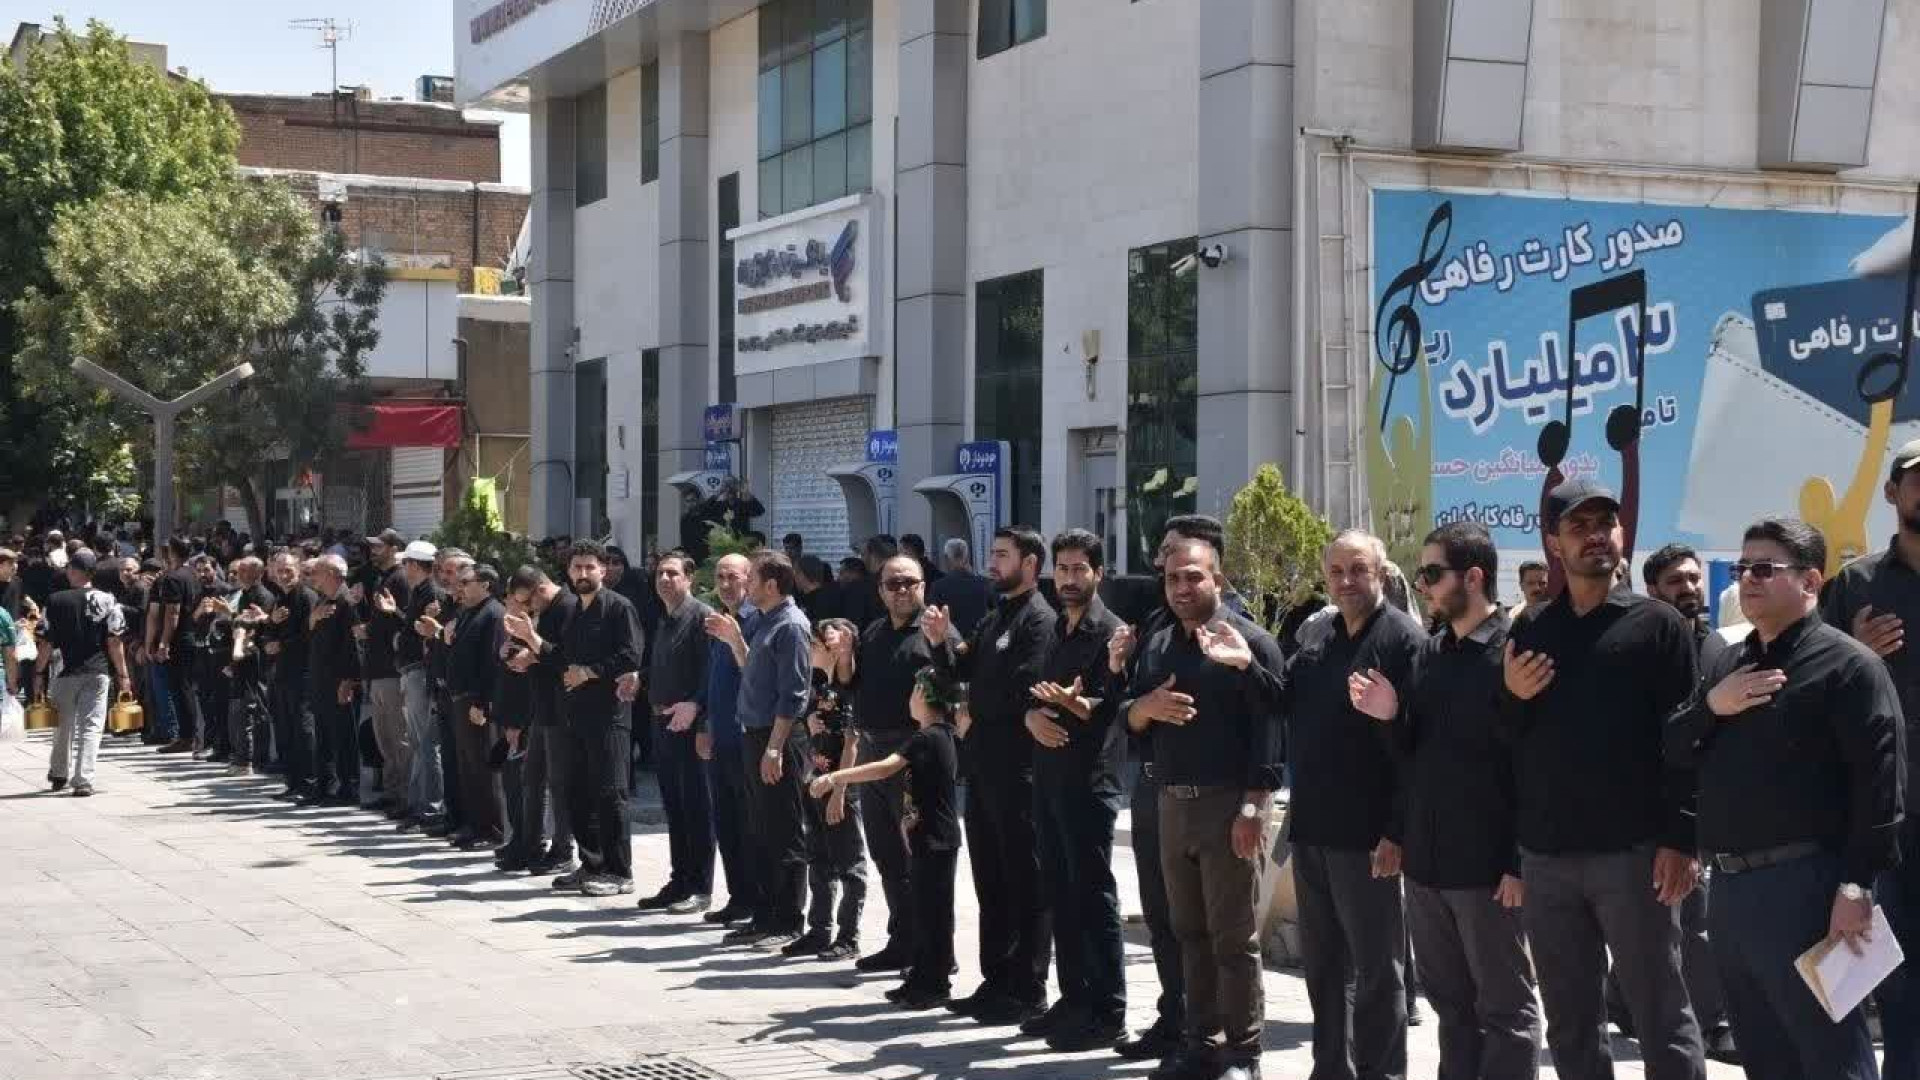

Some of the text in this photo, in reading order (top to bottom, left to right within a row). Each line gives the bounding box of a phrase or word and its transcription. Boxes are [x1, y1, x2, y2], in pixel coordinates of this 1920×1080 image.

[1416, 218, 1684, 306] صدور کارت رفاهی
[1788, 313, 1867, 361] رفاهی
